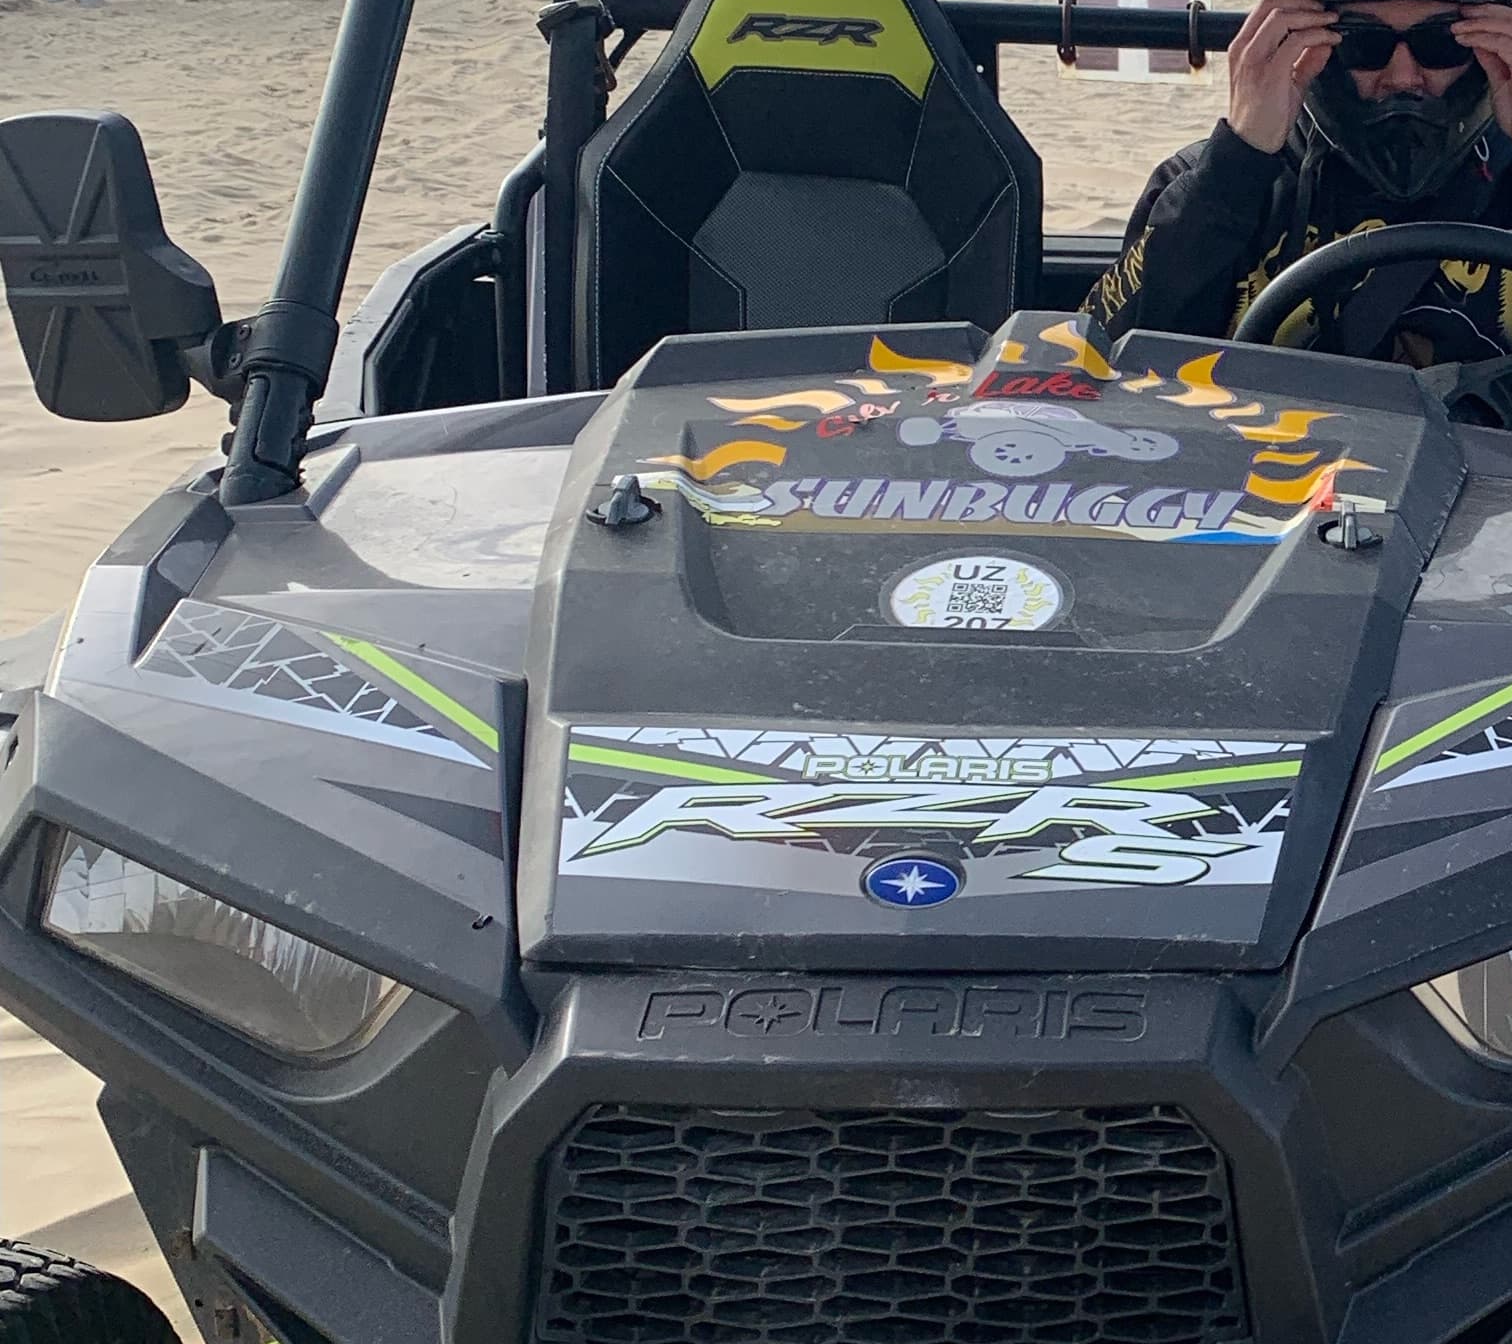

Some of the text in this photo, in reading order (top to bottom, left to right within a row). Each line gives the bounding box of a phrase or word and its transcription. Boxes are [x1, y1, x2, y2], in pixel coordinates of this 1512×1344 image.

[727, 12, 885, 48] RZR
[971, 370, 1102, 401] Lake
[763, 478, 1249, 530] SUNBUGGY
[952, 563, 1008, 582] UZ
[801, 752, 1054, 784] POLARIS
[569, 782, 1222, 863] RZR
[635, 985, 1149, 1043] POLARIS
